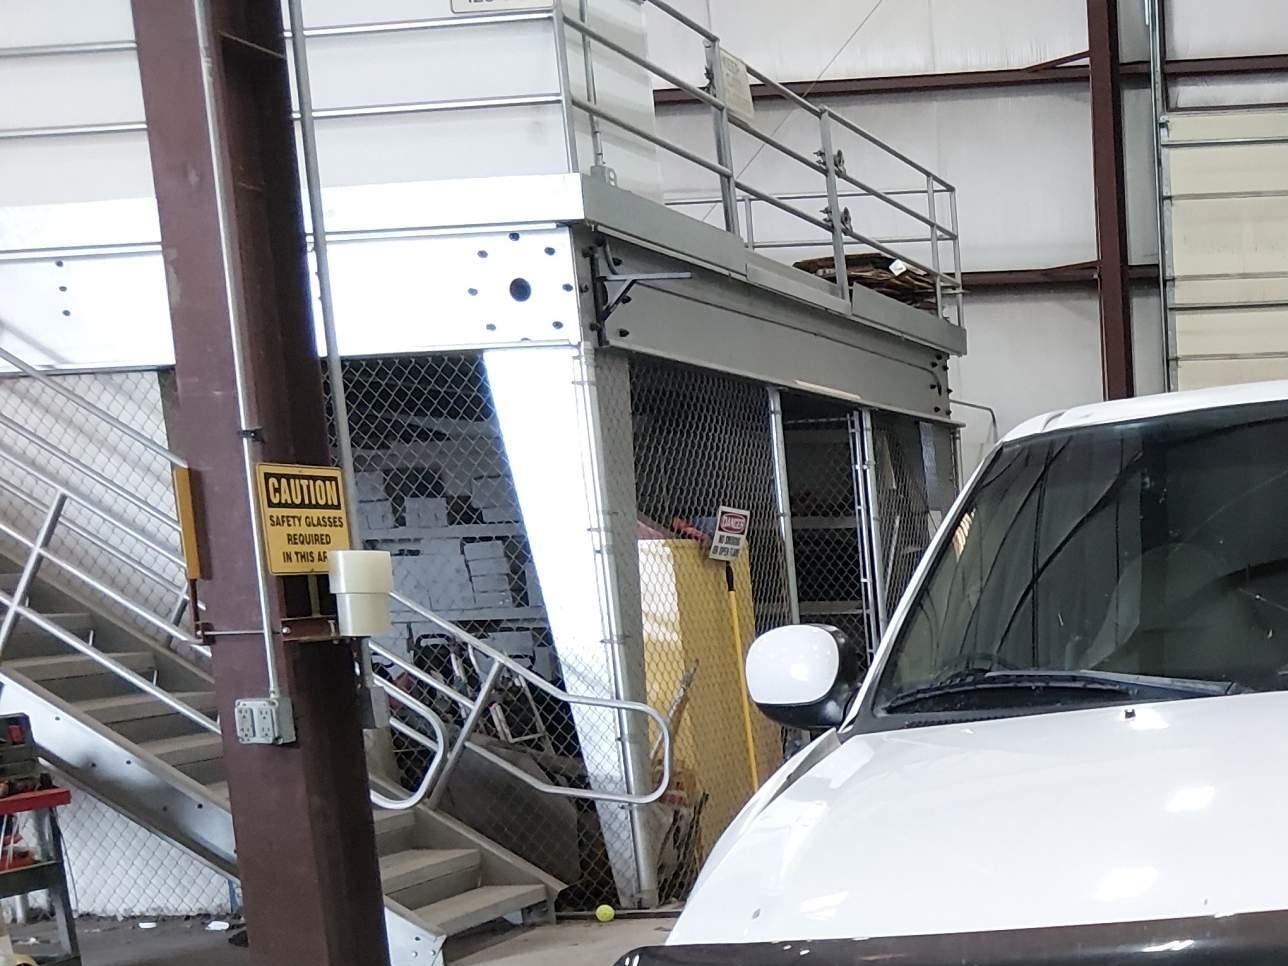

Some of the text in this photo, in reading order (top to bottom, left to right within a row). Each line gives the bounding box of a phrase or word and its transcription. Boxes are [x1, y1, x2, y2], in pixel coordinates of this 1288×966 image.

[269, 477, 339, 506] CAUTION
[269, 515, 344, 528] SAFETY GLASSES
[287, 533, 331, 545] REQUIRED
[283, 551, 329, 563] IN THIS AR
